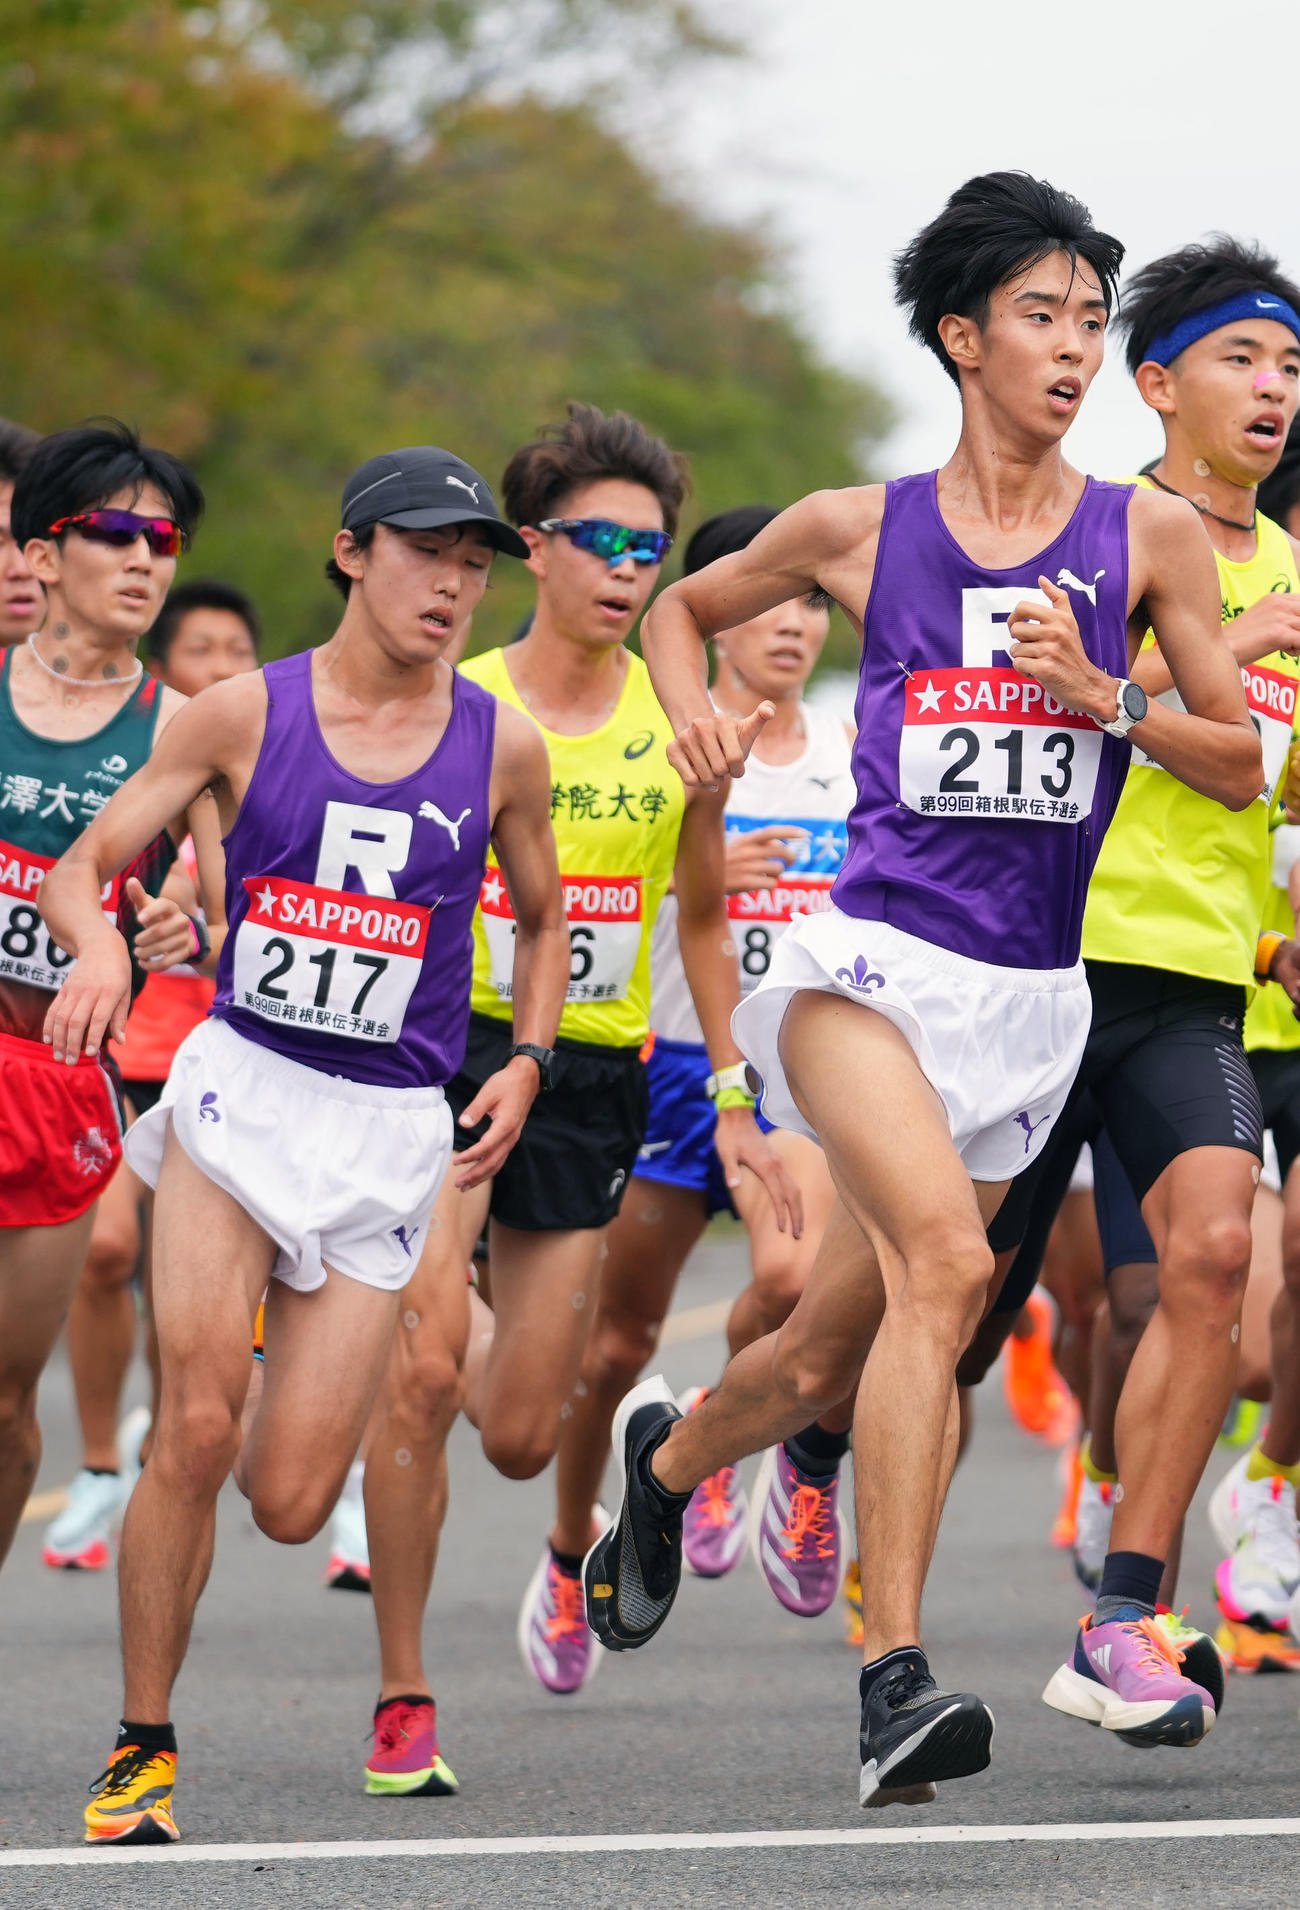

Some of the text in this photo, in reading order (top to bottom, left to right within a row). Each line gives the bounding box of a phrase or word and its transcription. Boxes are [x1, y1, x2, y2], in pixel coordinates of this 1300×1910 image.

[962, 587, 1053, 668] R
[954, 681, 1095, 718] SAPPO
[939, 727, 1075, 798] 213
[920, 795, 1079, 819] 第99回箱根駅伝予選会
[314, 801, 413, 900] R
[279, 893, 421, 946] SAPPORO
[257, 937, 389, 1016] 217
[245, 992, 390, 1037] 第99回箱根駅伝予選会
